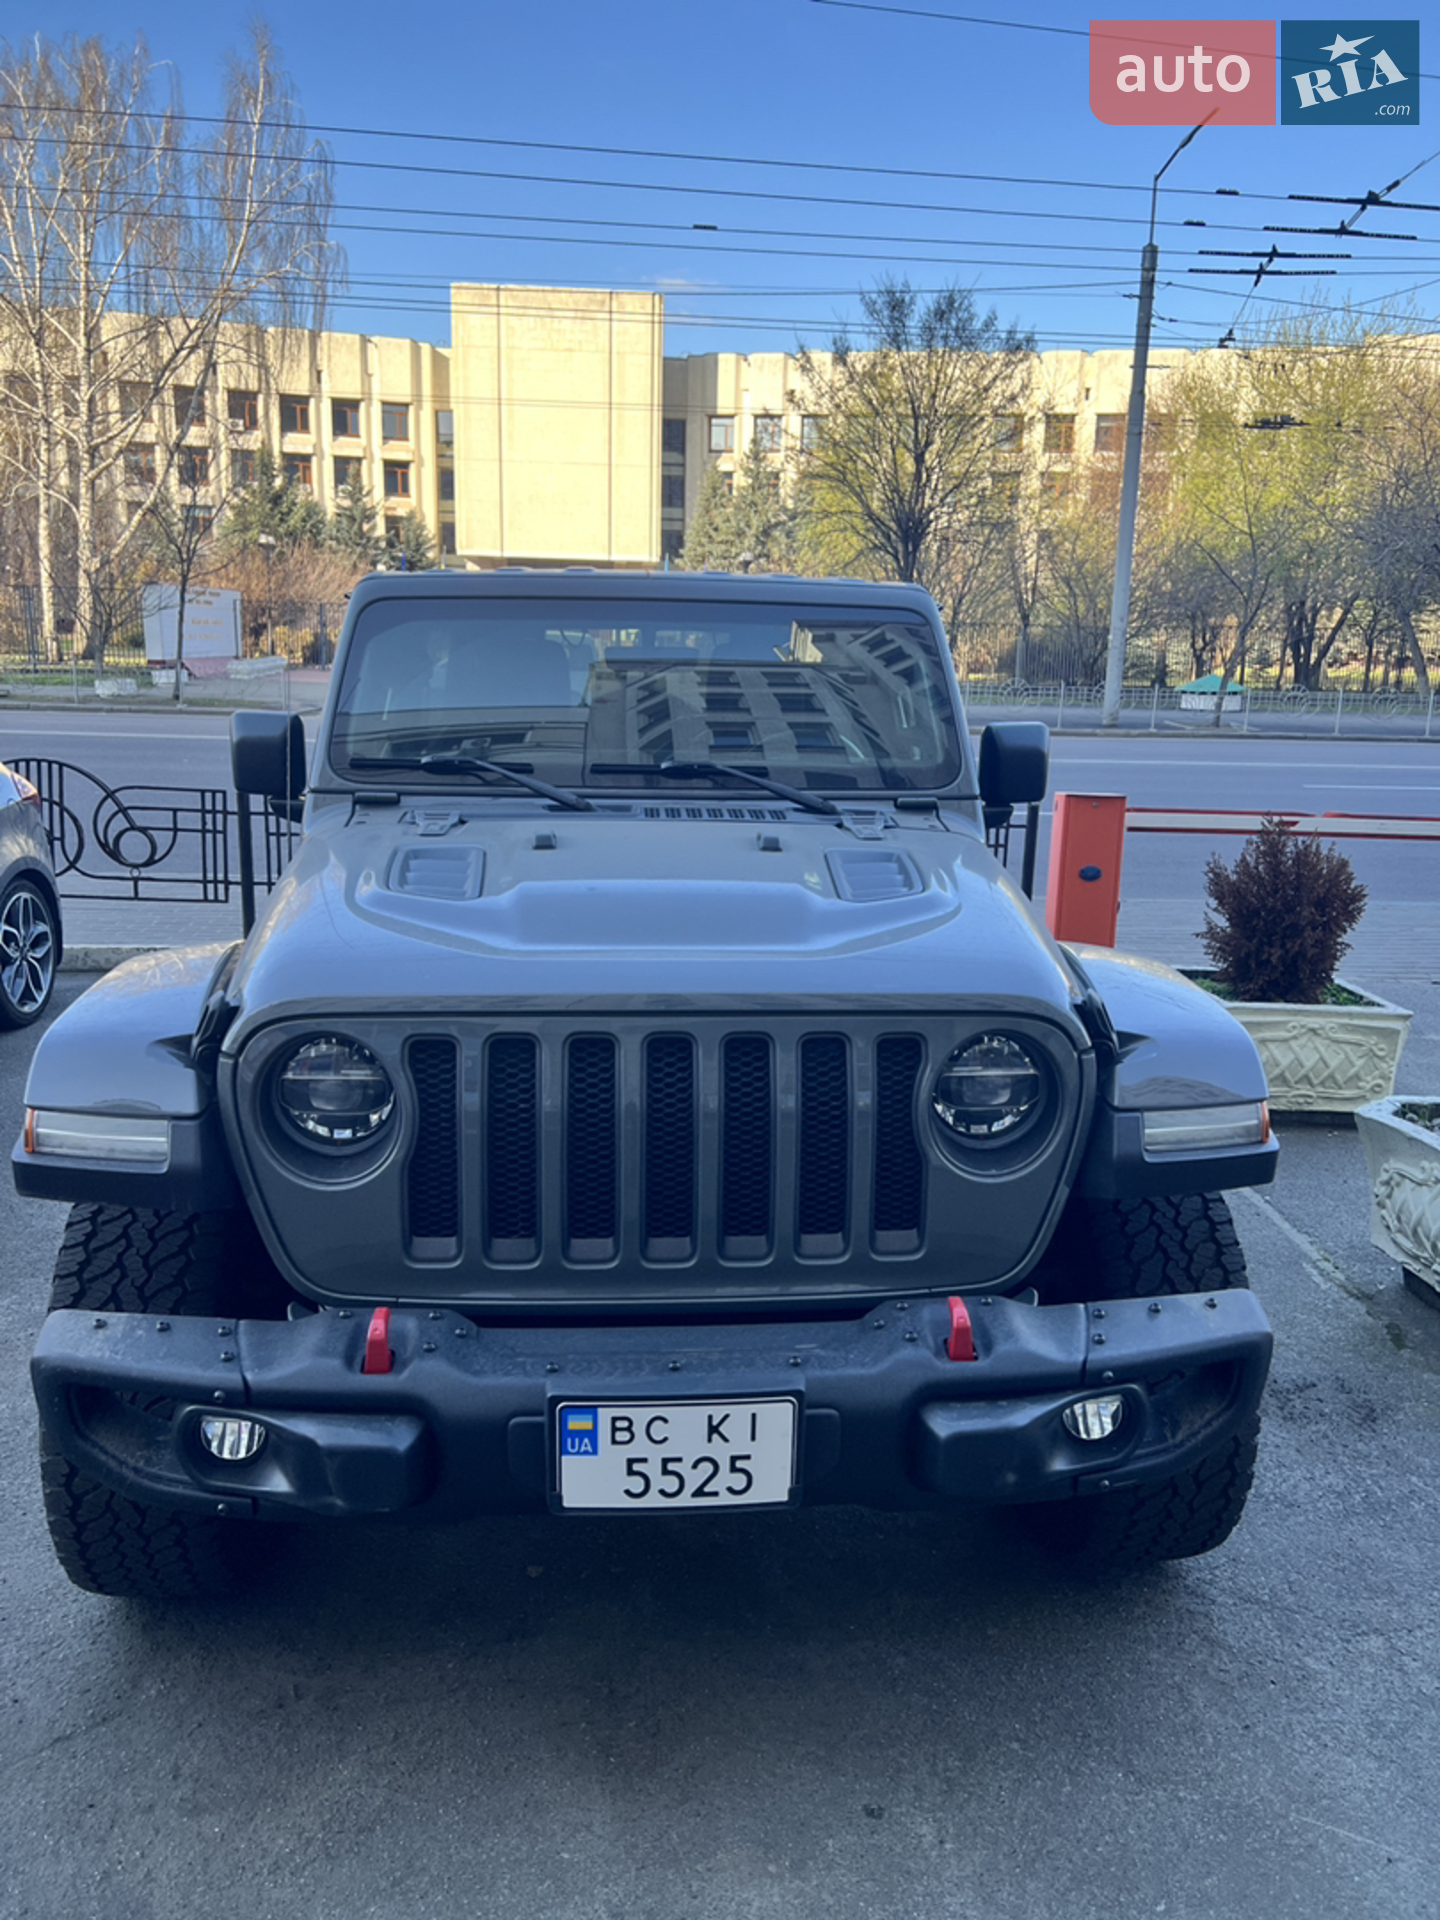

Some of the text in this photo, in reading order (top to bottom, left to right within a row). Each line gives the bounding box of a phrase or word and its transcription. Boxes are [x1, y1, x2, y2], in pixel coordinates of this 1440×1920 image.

[567, 1437, 593, 1454] UA
[610, 1412, 757, 1446] BC KI
[623, 1453, 755, 1500] 5525
